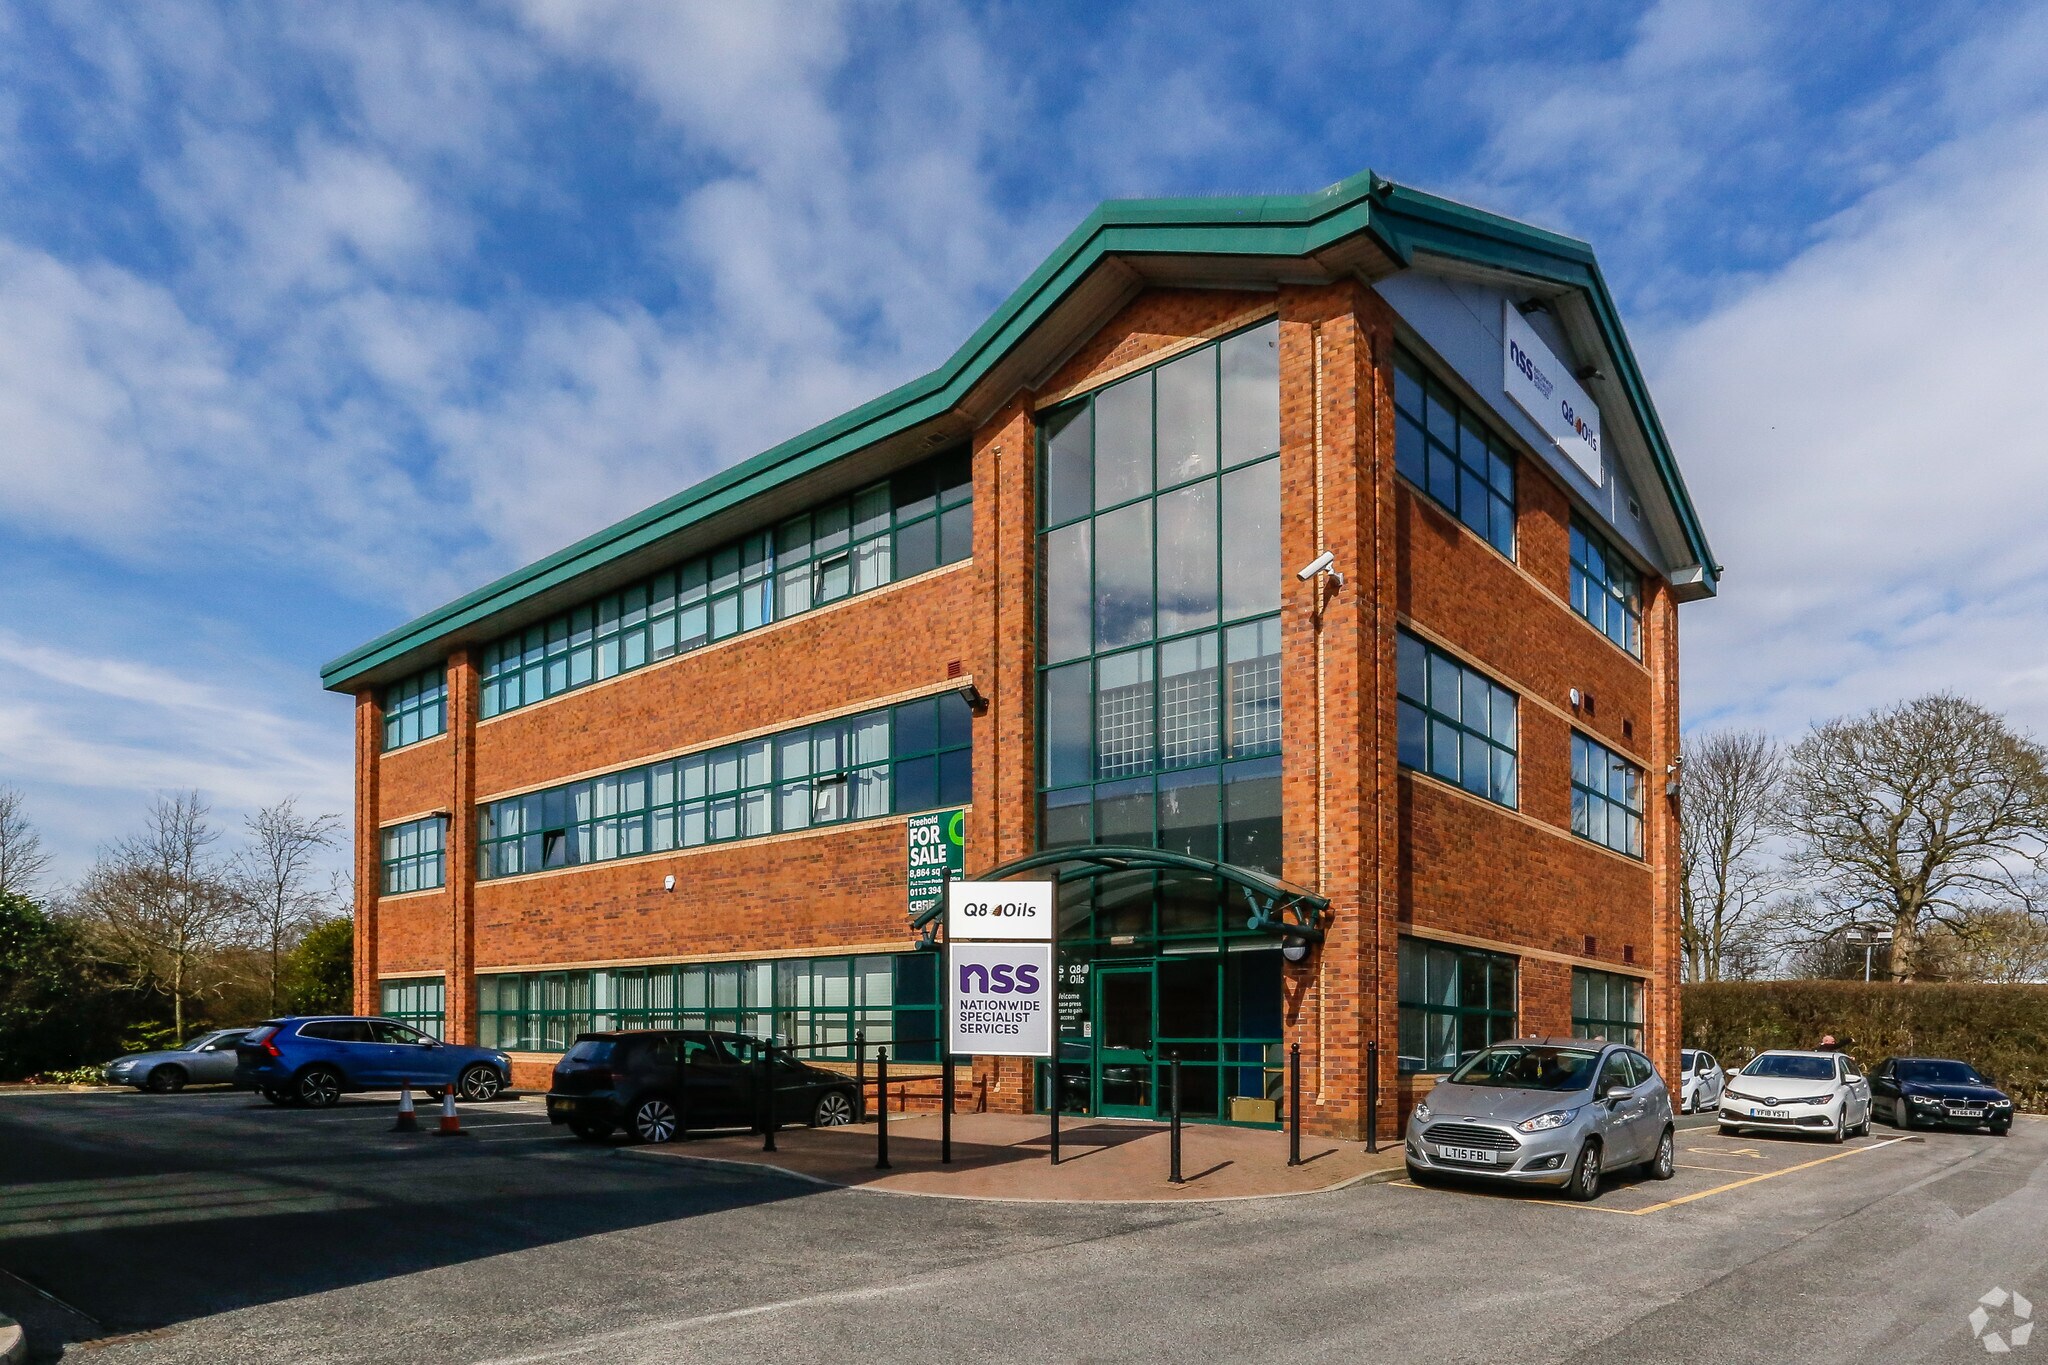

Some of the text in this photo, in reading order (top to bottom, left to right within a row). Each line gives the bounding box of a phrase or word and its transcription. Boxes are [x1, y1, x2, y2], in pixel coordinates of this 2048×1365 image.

[1510, 339, 1533, 381] nss
[1562, 400, 1596, 451] Q8 Oils
[910, 815, 938, 827] Freehold
[910, 825, 940, 846] FOR
[911, 844, 947, 867] SALE
[910, 868, 930, 879] 8,864
[931, 868, 941, 876] sq
[910, 885, 942, 897] 0113 394
[964, 903, 1036, 917] Q8 Oils
[1069, 965, 1081, 974] Q8
[960, 964, 1040, 994] nss
[1069, 975, 1085, 984] Oils
[960, 1000, 1040, 1011] NATIONWIDE
[960, 1012, 1030, 1022] SPECIALIST
[960, 1023, 1019, 1034] SERVICES
[1445, 1147, 1490, 1161] LT15 FBL
